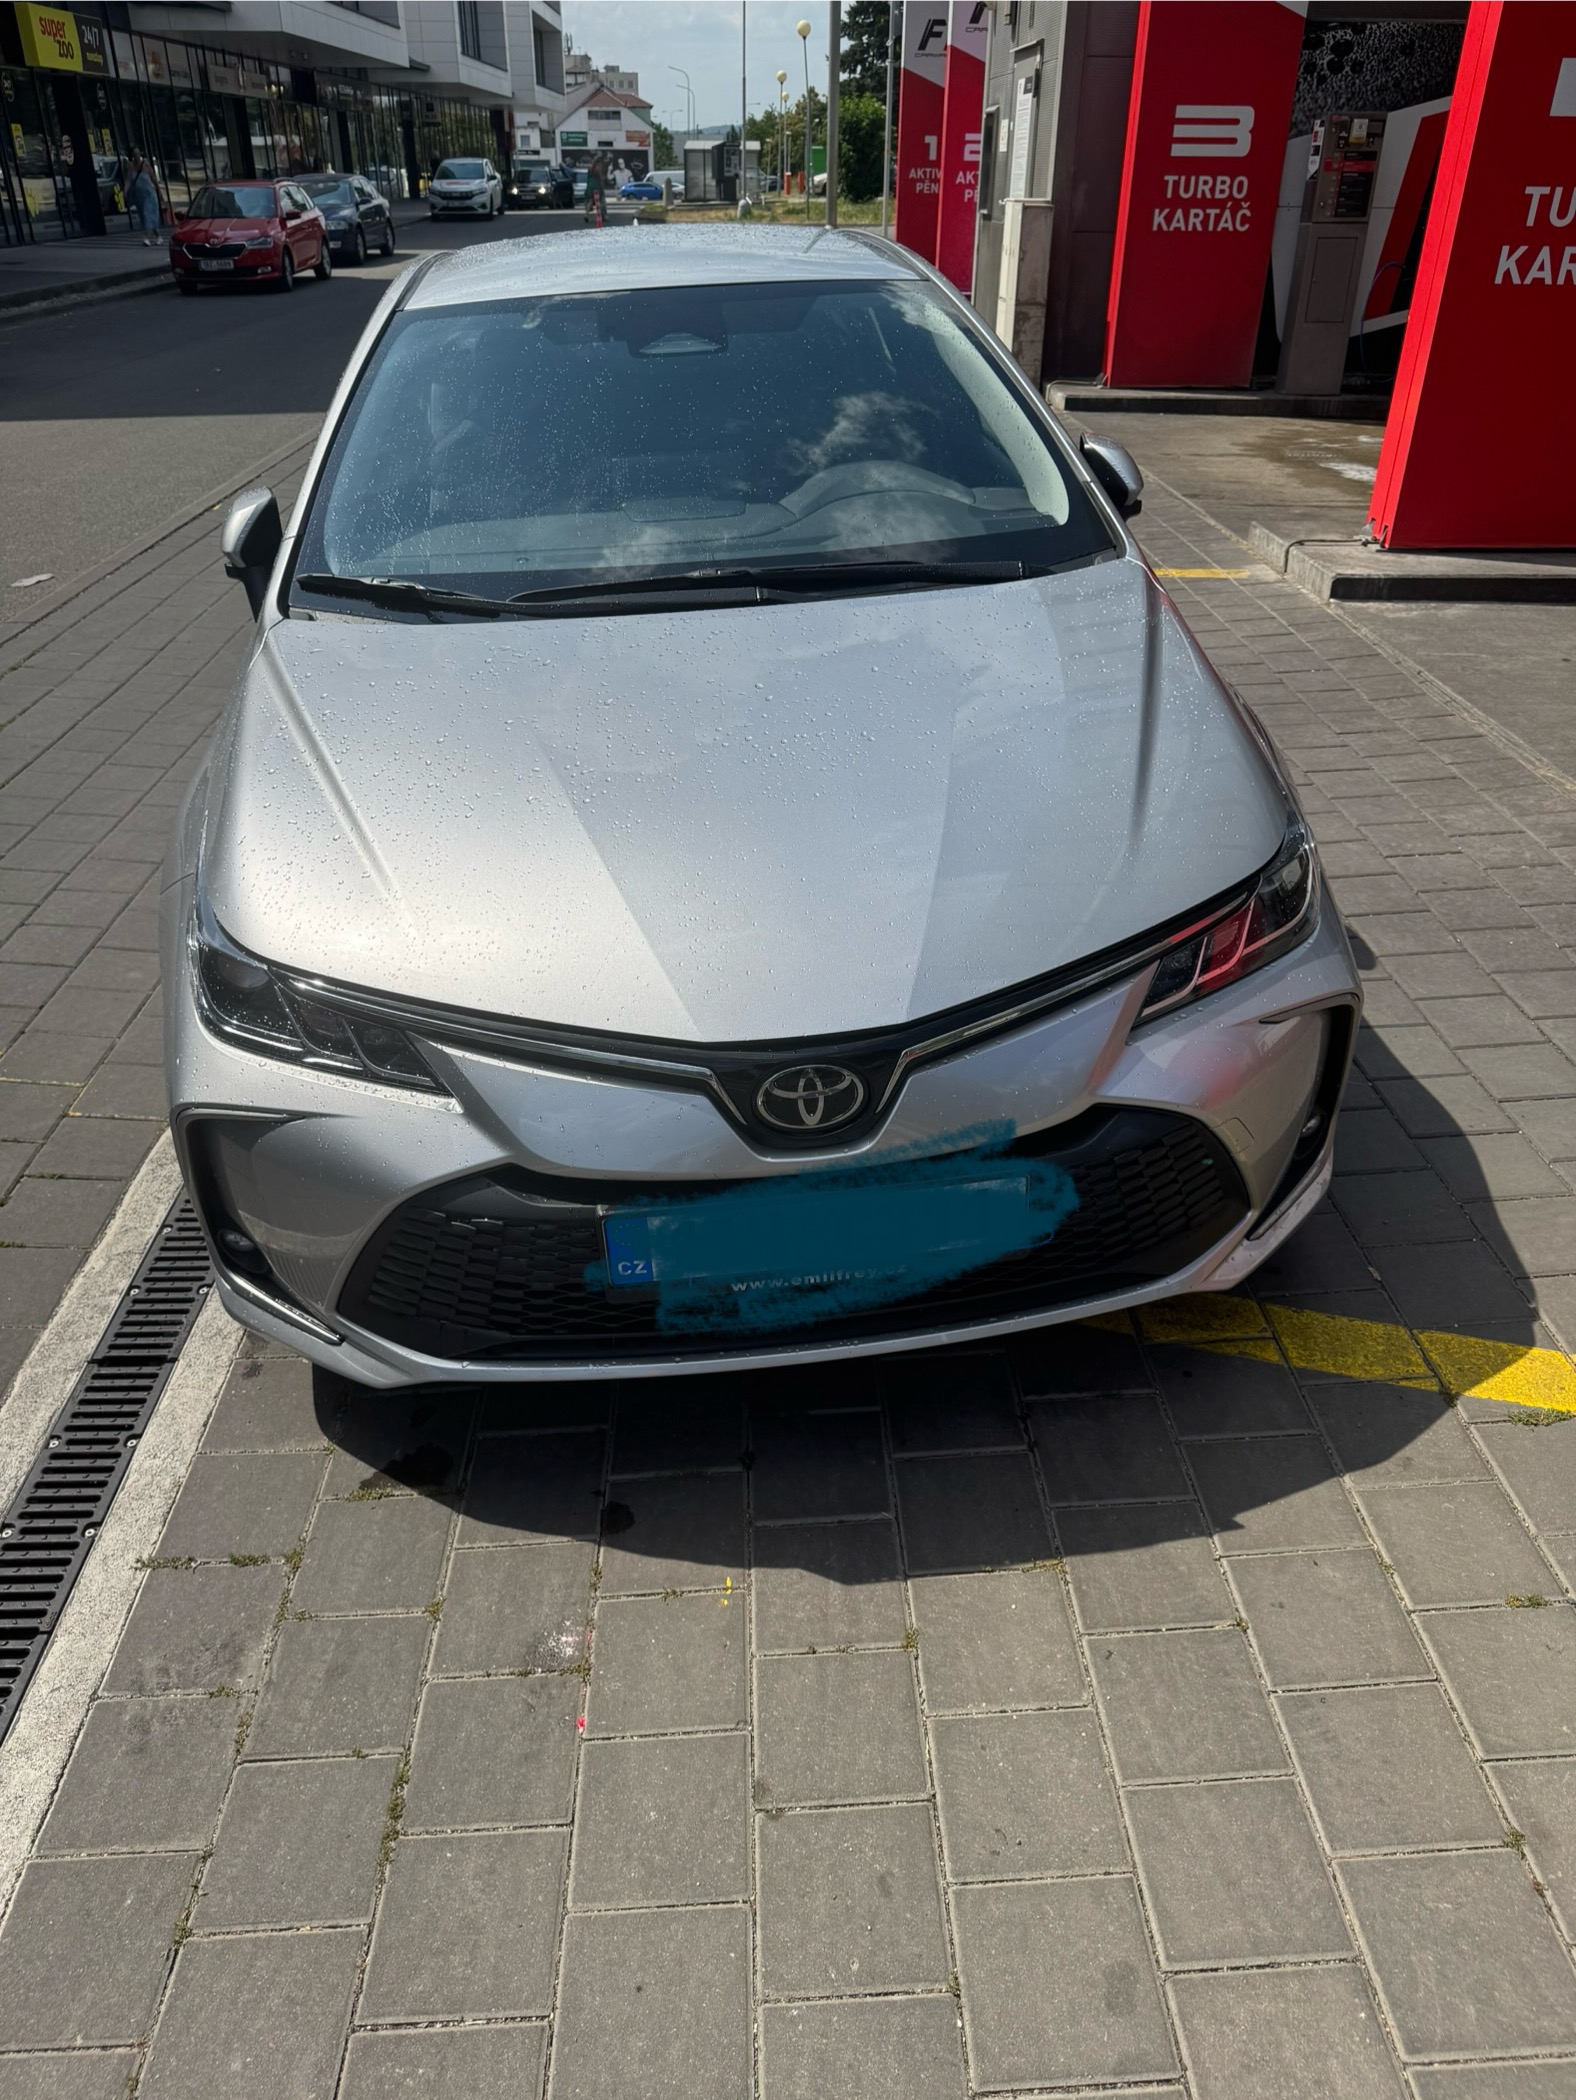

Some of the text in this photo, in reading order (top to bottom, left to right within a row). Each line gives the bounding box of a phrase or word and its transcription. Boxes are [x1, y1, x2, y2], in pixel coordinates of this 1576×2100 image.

[39, 16, 66, 41] super
[81, 25, 99, 49] 24/7
[917, 18, 947, 51] F
[1170, 105, 1255, 157] 3
[924, 135, 937, 160] 1
[963, 133, 981, 161] 2
[916, 179, 939, 194] PĚN
[1164, 175, 1249, 199] TURBO
[1152, 201, 1252, 232] KARTÁČ
[617, 1260, 648, 1276] CZ
